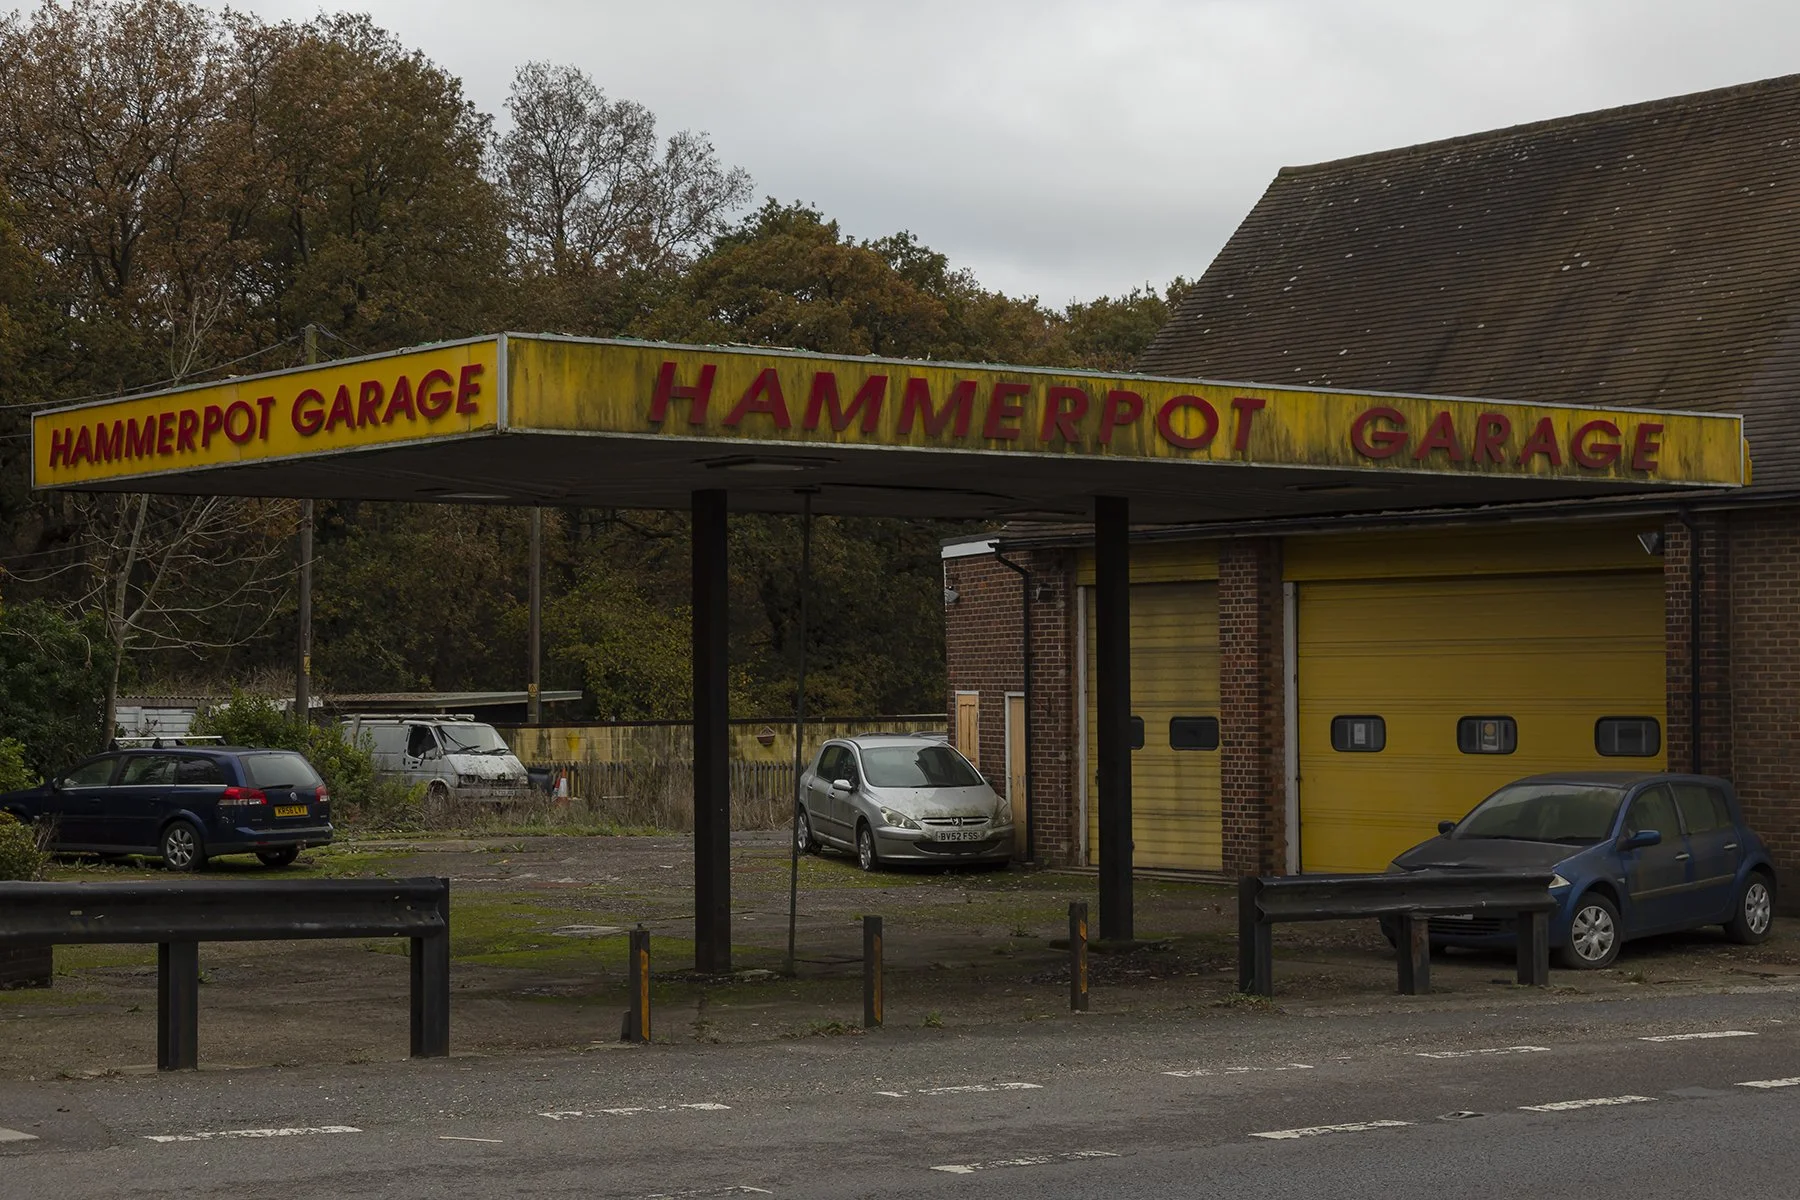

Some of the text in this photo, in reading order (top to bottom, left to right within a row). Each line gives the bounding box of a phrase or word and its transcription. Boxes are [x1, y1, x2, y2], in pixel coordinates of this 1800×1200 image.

[49, 364, 483, 468] HAMMERPOT GARAGE
[649, 362, 1665, 471] HAMMERPOT GARAGE
[940, 832, 978, 841] BV52 FSS
